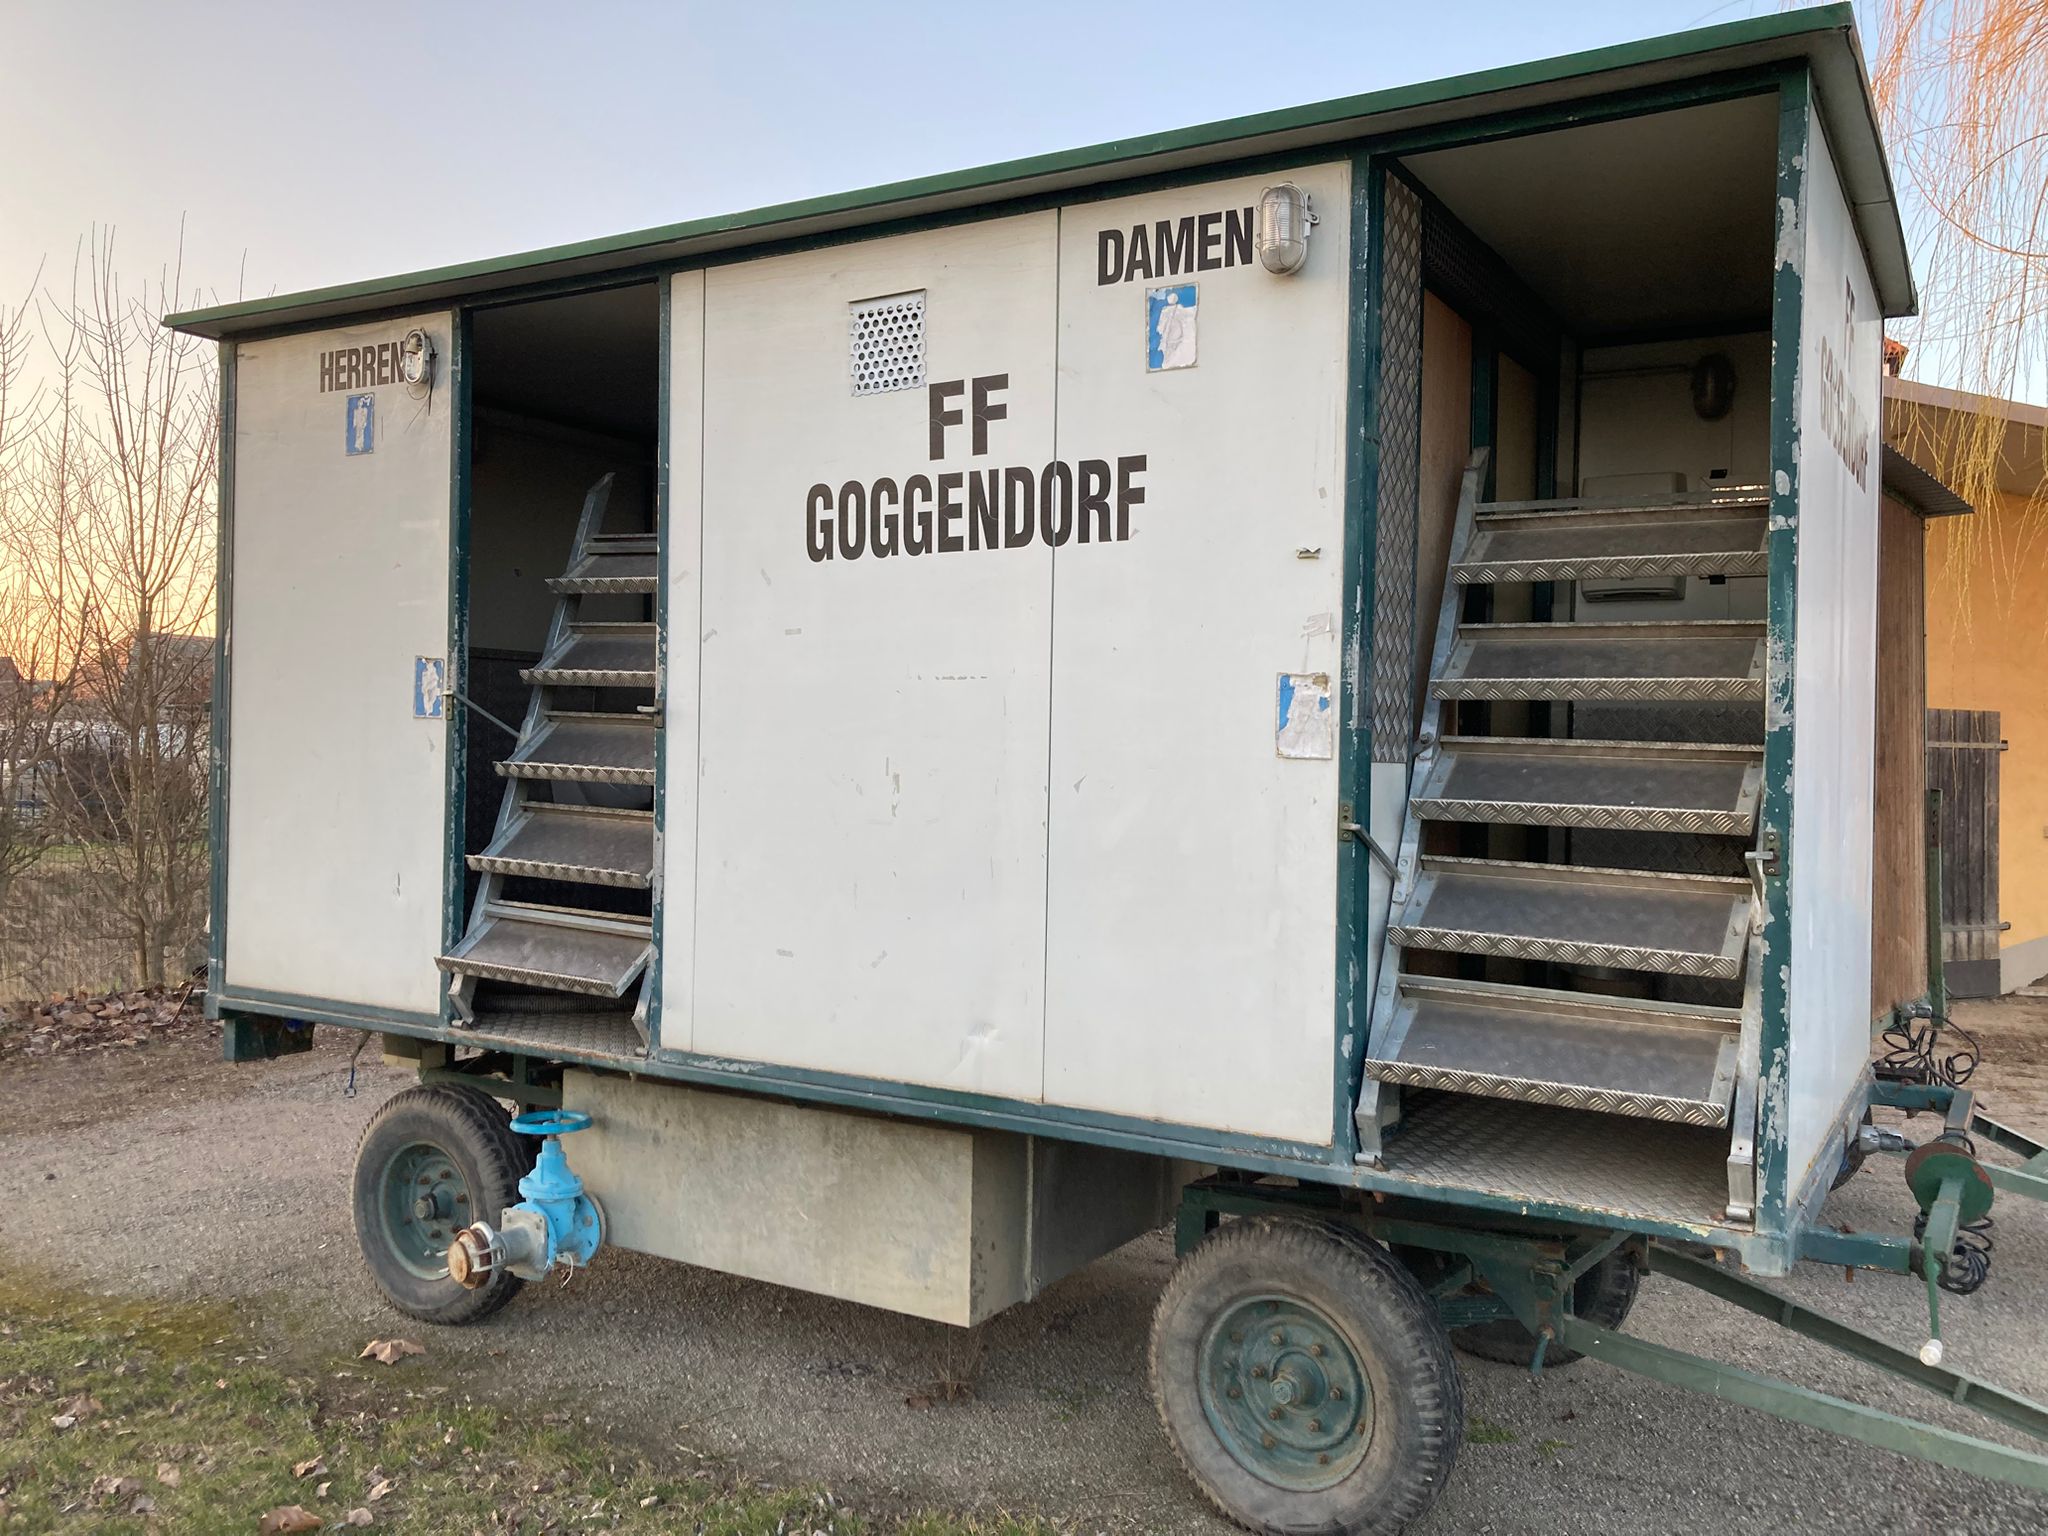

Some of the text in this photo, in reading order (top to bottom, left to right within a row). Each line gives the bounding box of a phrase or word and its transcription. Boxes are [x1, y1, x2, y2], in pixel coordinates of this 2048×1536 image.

[1098, 206, 1254, 286] DAMEN
[320, 340, 405, 393] HERREN
[928, 373, 1009, 461] FF
[806, 453, 1148, 563] GOGGENDORF
